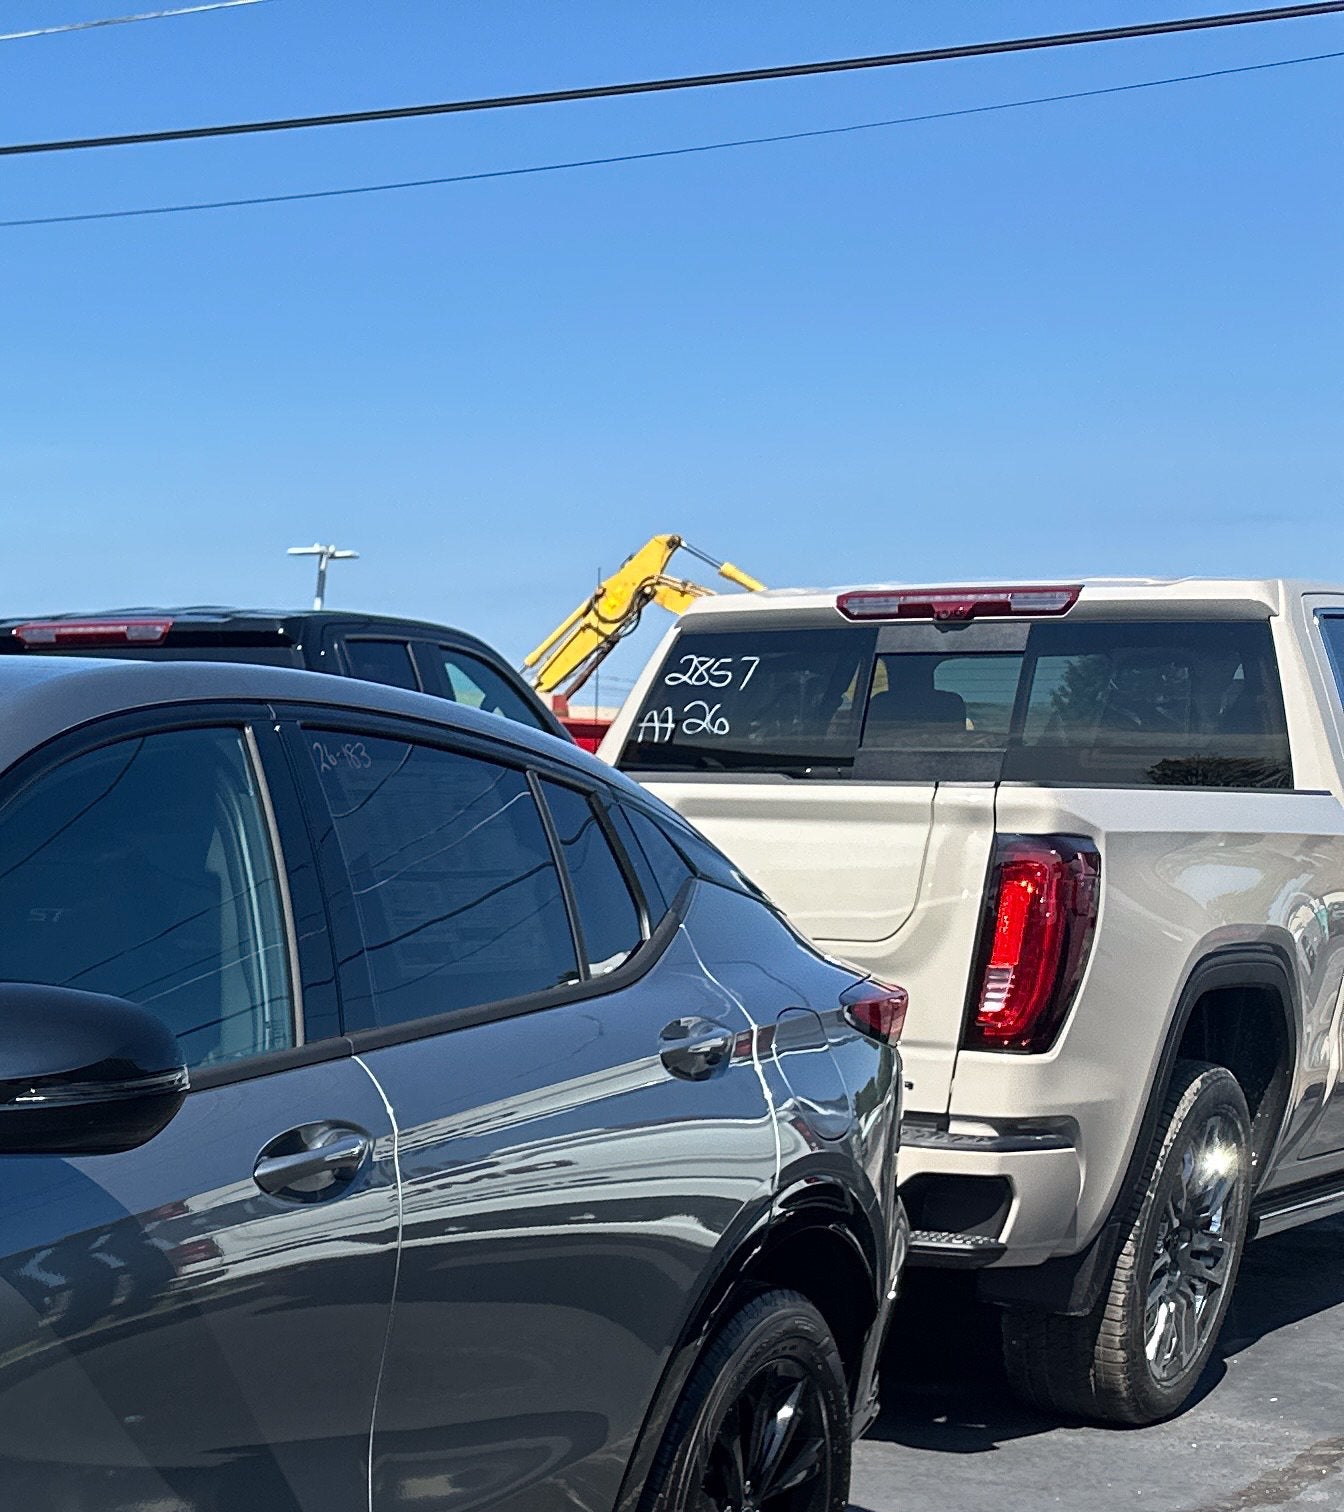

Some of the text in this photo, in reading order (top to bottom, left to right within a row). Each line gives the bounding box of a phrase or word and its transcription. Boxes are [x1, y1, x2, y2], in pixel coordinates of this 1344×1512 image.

[664, 654, 761, 692] 2857
[682, 700, 730, 735] 26
[313, 742, 372, 773] 26-183
